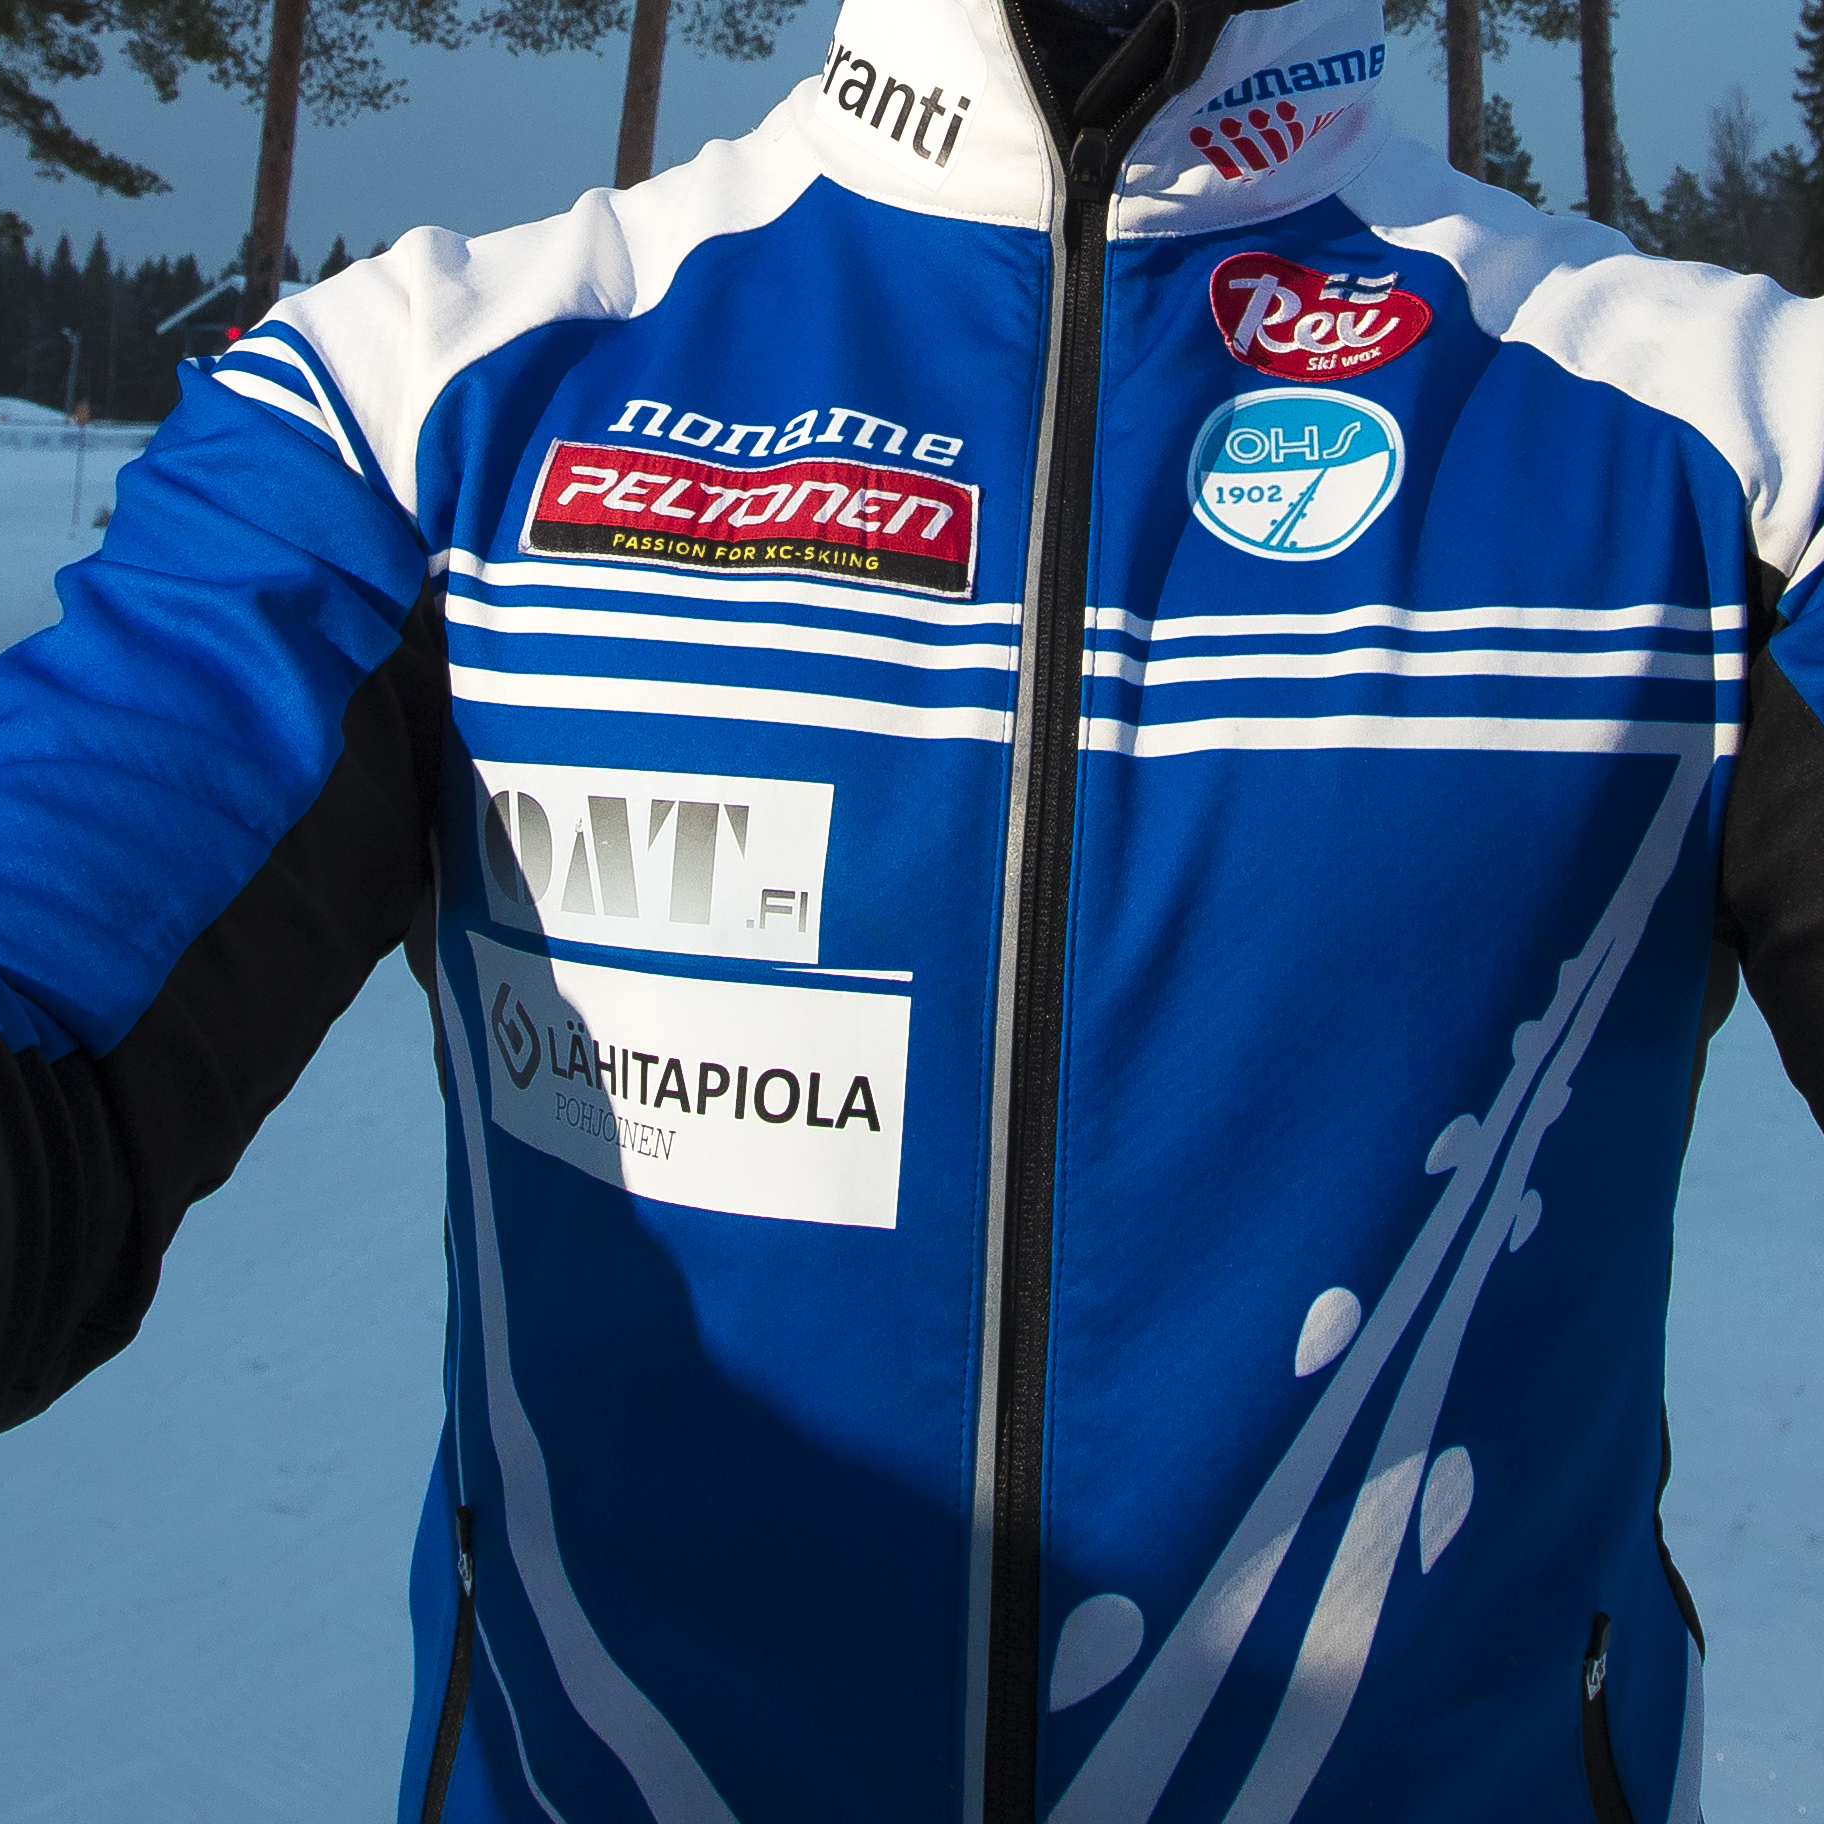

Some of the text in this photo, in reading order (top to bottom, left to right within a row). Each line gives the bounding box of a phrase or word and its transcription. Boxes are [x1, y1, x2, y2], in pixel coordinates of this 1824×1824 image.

[823, 42, 971, 169] ranti
[1192, 43, 1385, 116] oname
[1228, 273, 1399, 356] Rex
[607, 399, 964, 467] noname
[1226, 421, 1361, 464] OHS
[556, 465, 953, 540] PELTONEN
[1216, 485, 1283, 504] 1902
[613, 533, 880, 571] PASSION FOR XC-SKIING
[547, 1019, 881, 1132] LÄHITAPIOLA
[555, 1092, 676, 1160] POHJOINEN
